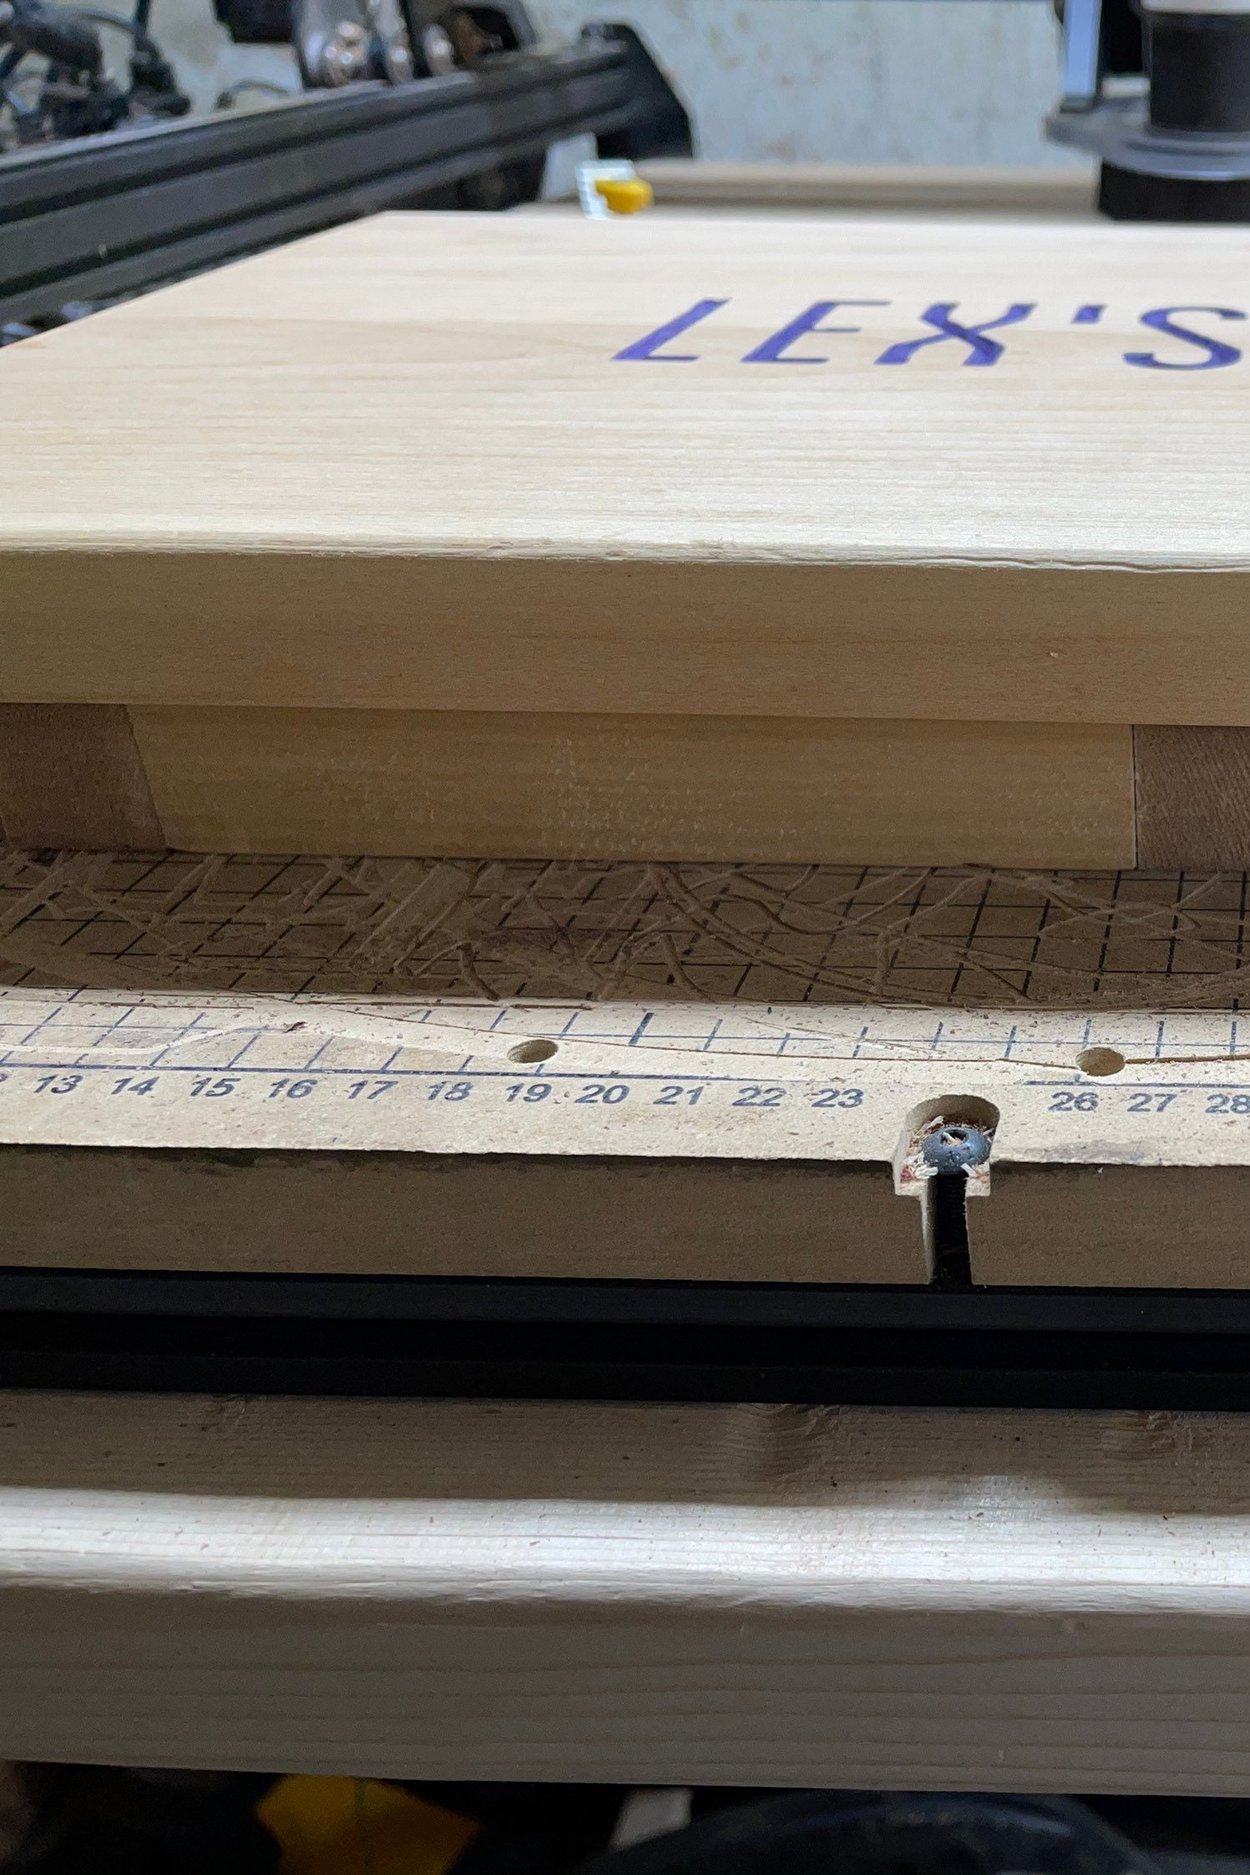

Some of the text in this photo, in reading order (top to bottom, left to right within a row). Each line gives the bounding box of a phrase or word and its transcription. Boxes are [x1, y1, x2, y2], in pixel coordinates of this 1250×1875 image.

[610, 297, 1249, 370] LEX'S
[34, 1074, 83, 1094] 13
[110, 1076, 161, 1096] 14
[189, 1077, 240, 1097] 15
[268, 1078, 319, 1098] 16
[347, 1080, 399, 1100] 17
[427, 1081, 473, 1101] 18
[506, 1083, 553, 1103] 19
[574, 1084, 630, 1104] 20
[652, 1085, 706, 1105] 21
[732, 1087, 788, 1107] 22
[811, 1088, 864, 1108] 23
[1048, 1092, 1101, 1112] 26
[1127, 1092, 1175, 1113] 27
